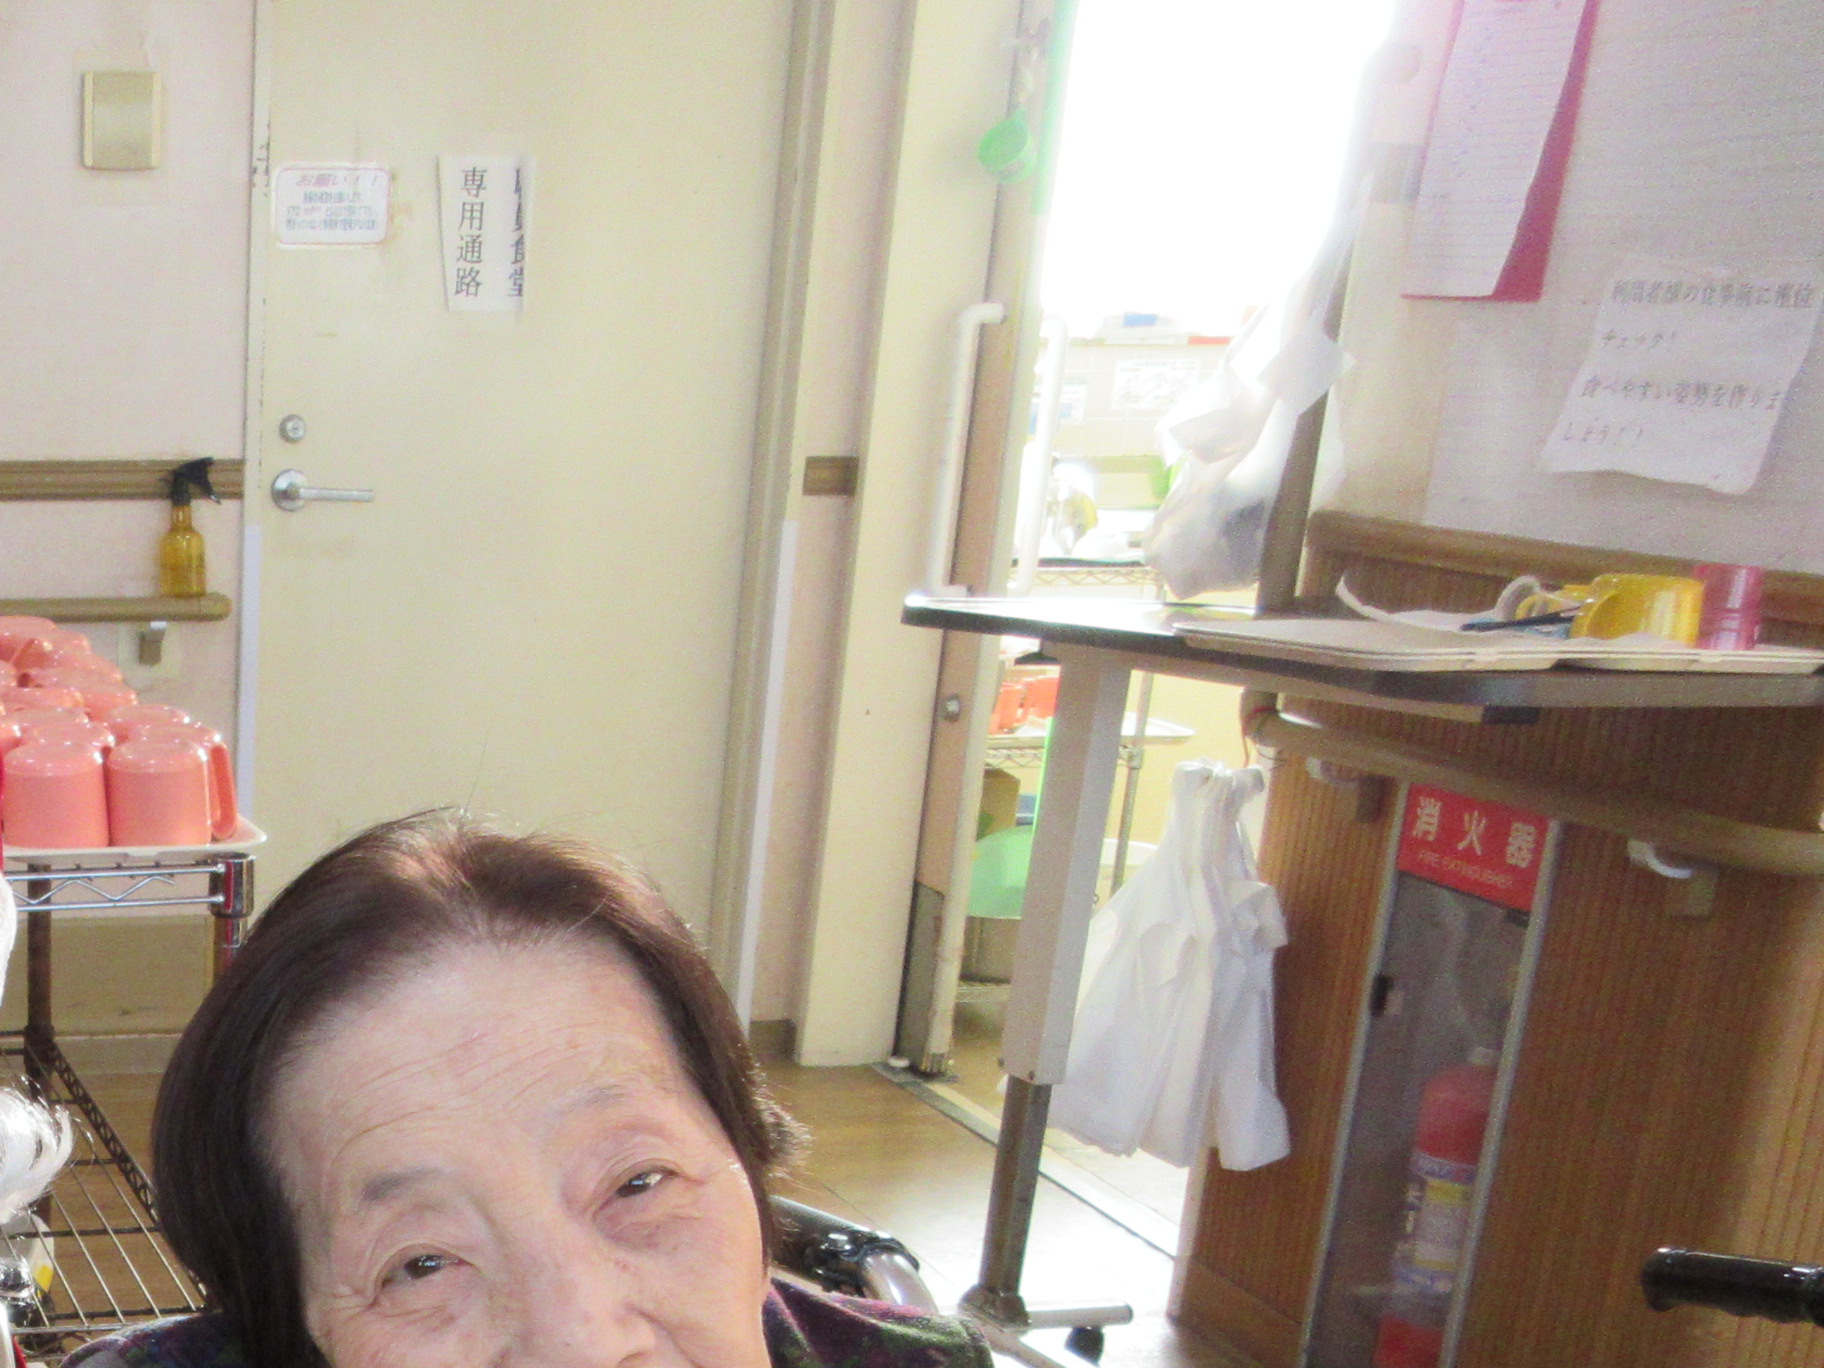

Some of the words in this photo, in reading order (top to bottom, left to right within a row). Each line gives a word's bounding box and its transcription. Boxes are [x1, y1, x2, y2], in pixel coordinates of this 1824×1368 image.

[454, 166, 487, 297] 専用通路
[1412, 796, 1537, 869] 消火器
